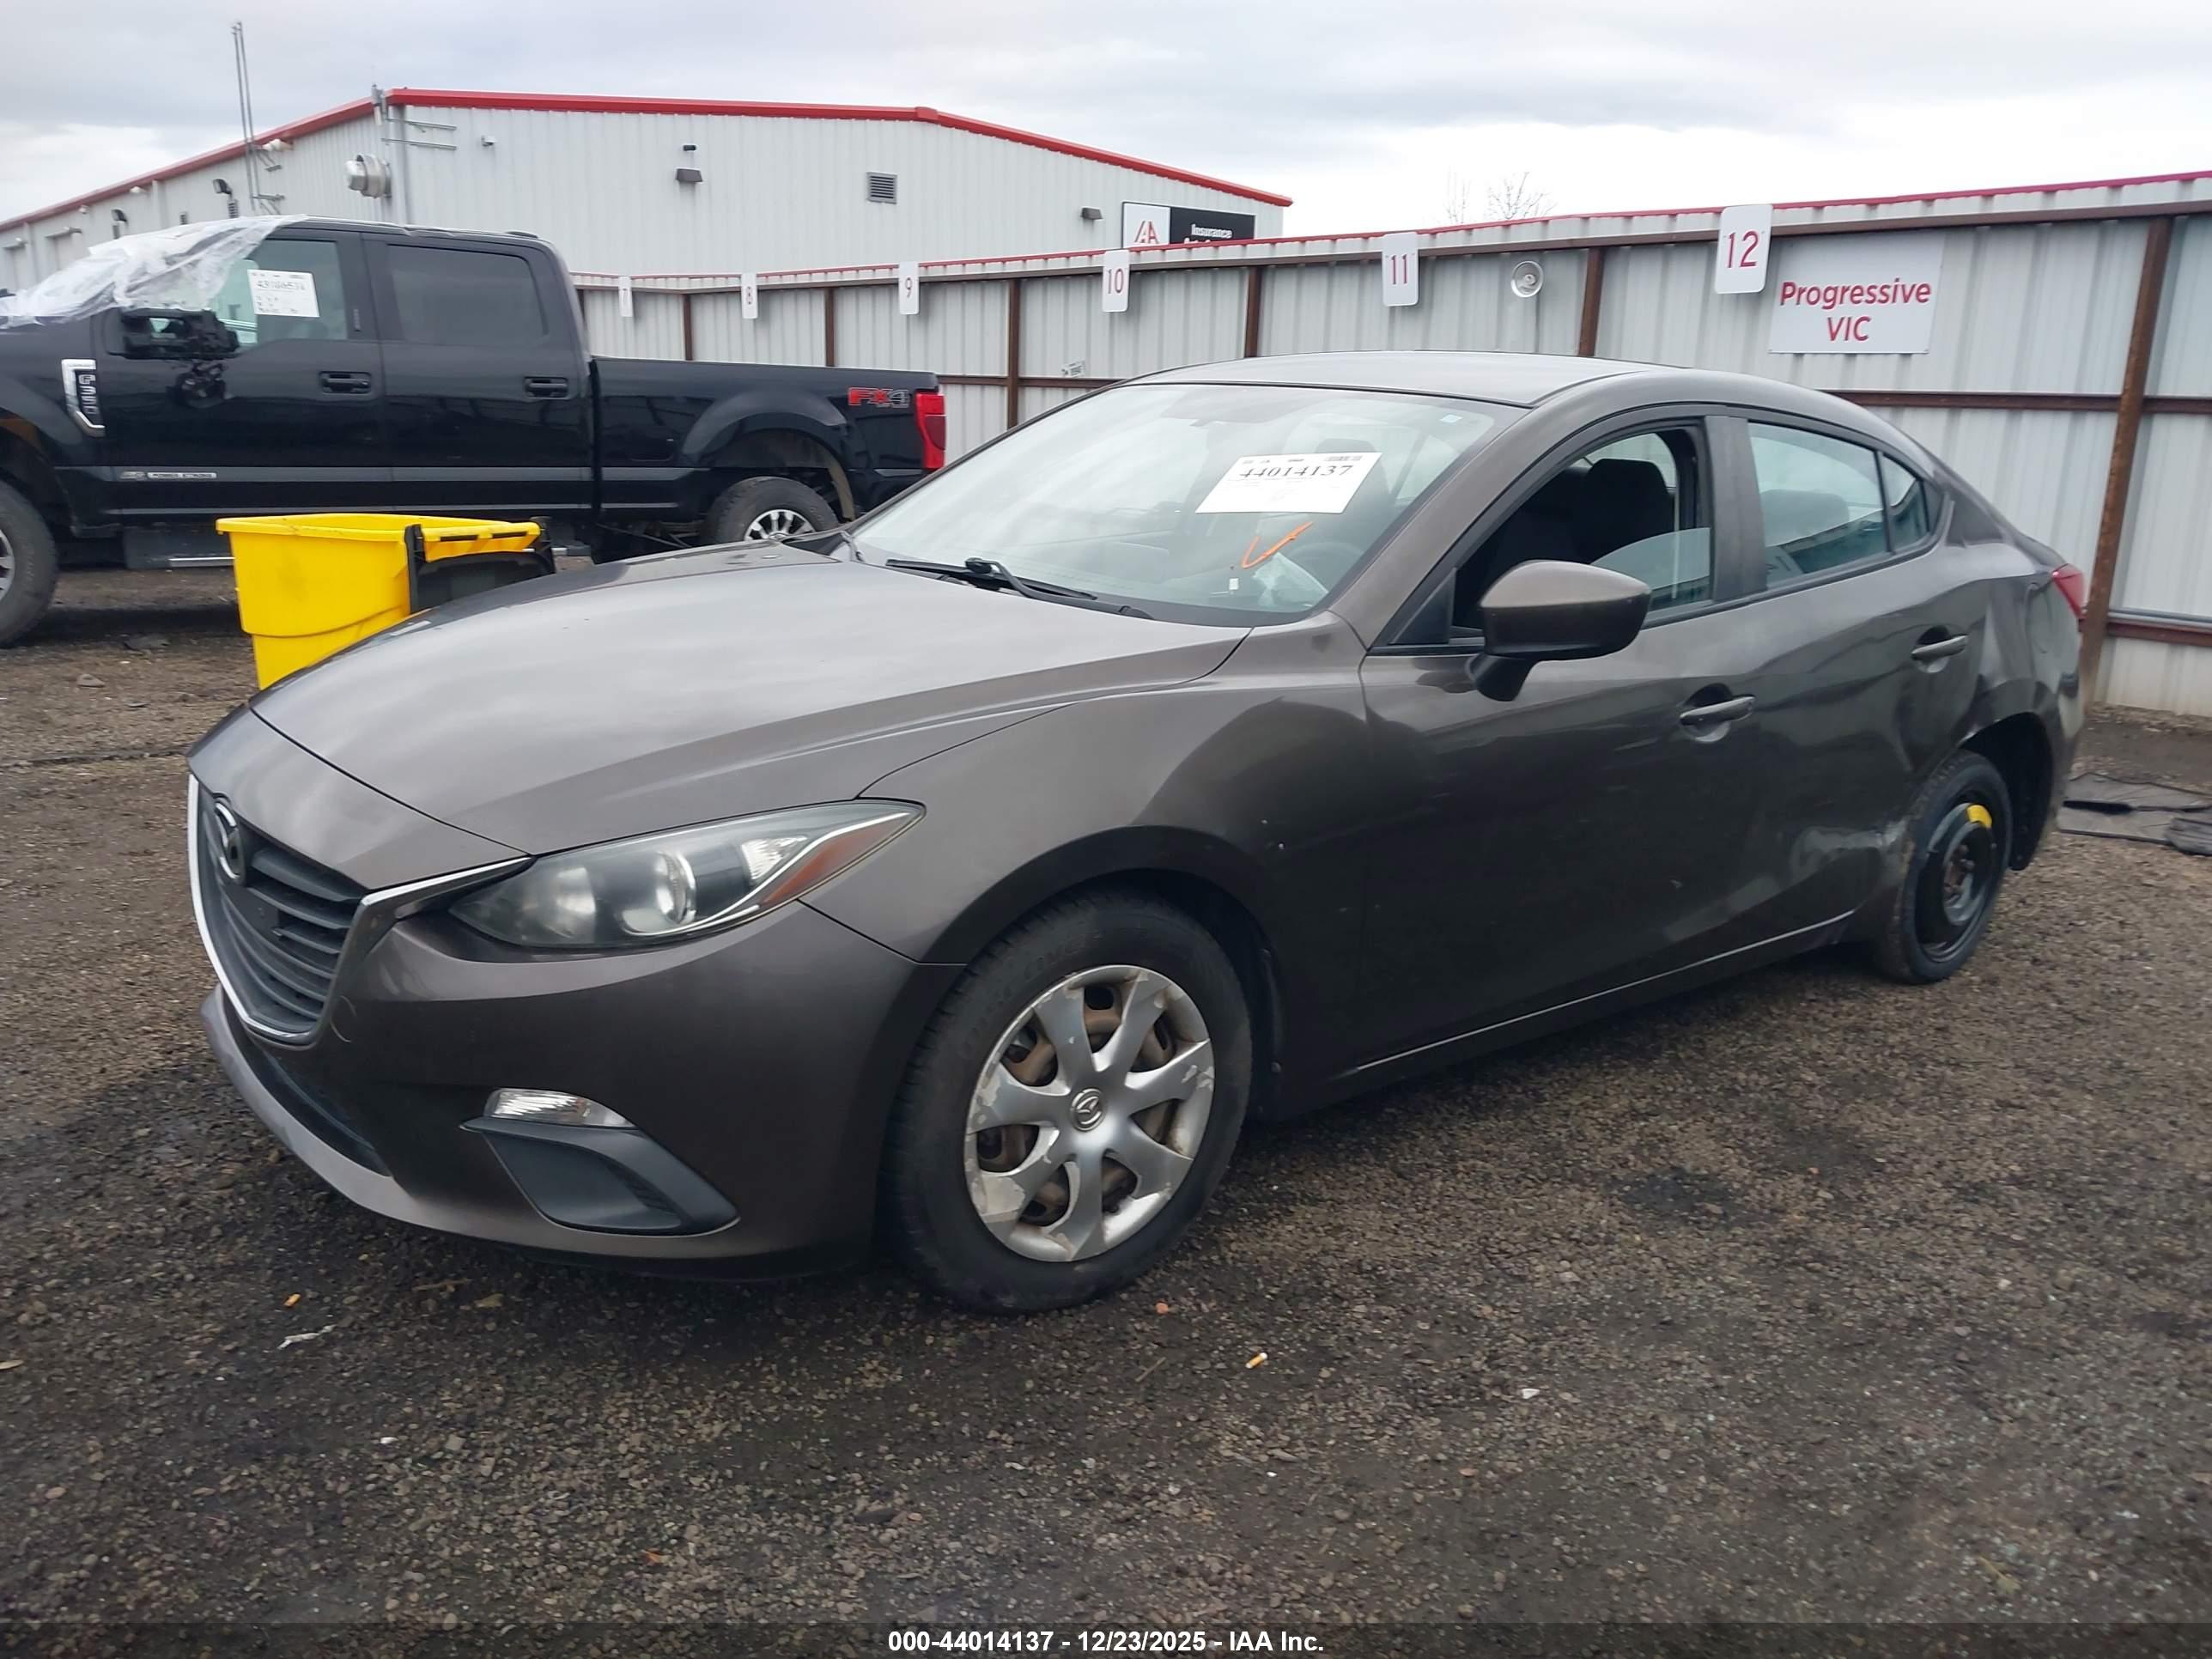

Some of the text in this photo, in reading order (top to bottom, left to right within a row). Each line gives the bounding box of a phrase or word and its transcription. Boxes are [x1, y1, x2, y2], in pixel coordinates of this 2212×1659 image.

[1191, 224, 1233, 239] Insurance
[1726, 230, 1759, 269] 12
[1108, 268, 1124, 294] 10
[1390, 254, 1408, 285] 11
[904, 276, 913, 299] 9
[1780, 277, 1931, 310] Progressive
[1826, 316, 1871, 342] VIC
[848, 386, 910, 406] FX4
[1239, 465, 1354, 478] 44014137
